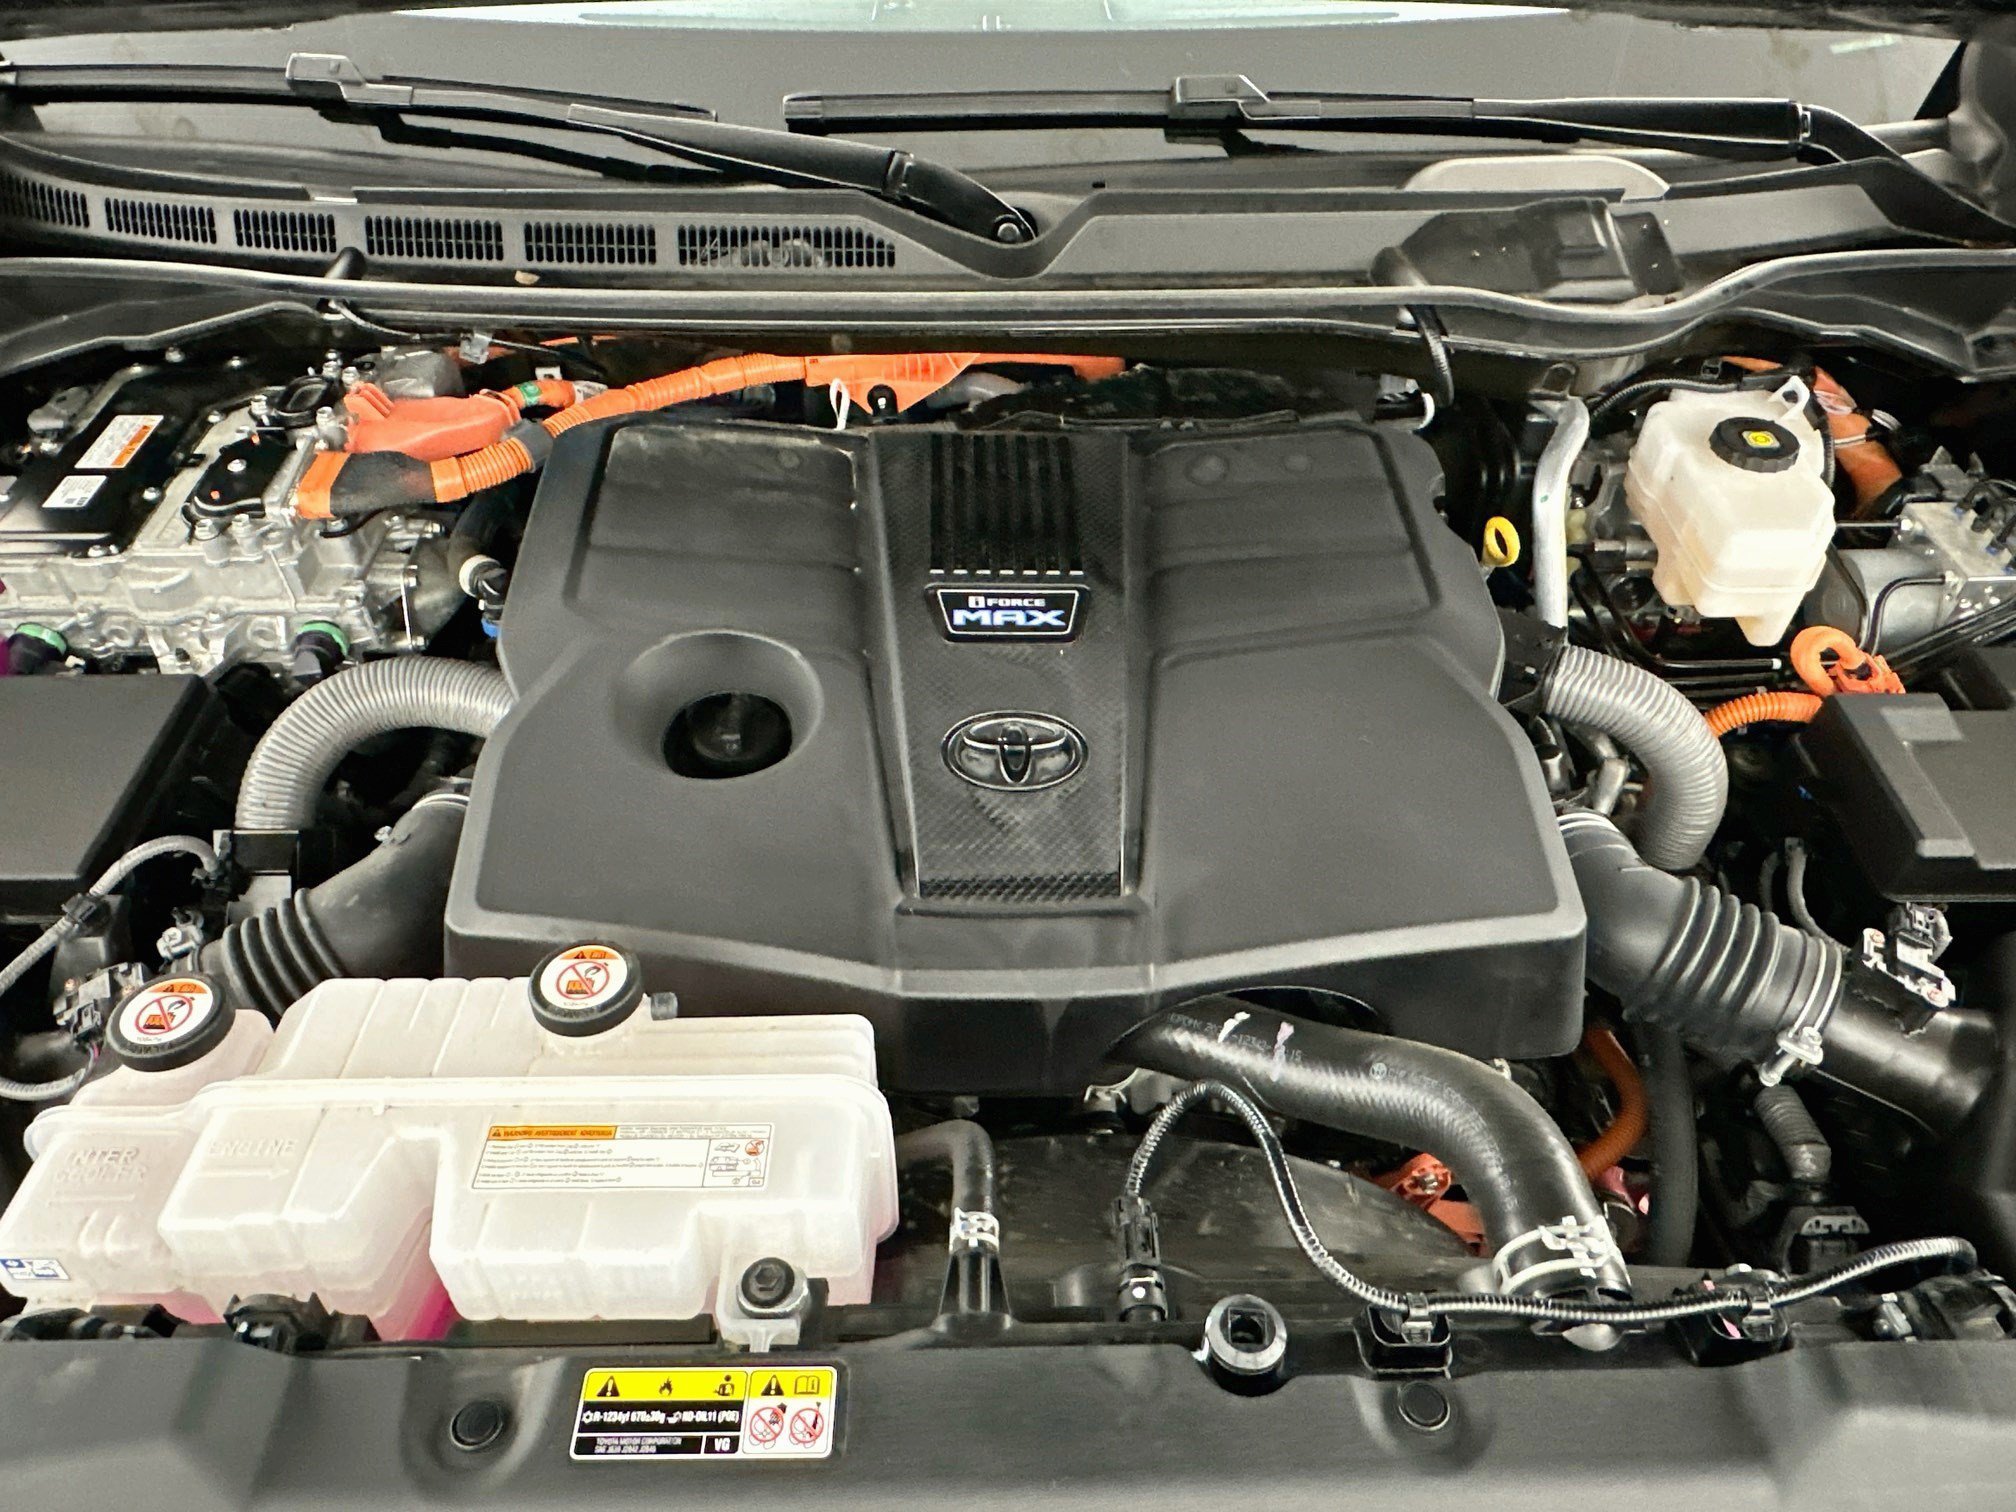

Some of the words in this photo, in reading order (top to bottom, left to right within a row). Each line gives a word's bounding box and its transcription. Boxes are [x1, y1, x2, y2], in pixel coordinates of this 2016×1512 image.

[952, 609, 1067, 626] MAX
[65, 1146, 140, 1166] INTER
[208, 1139, 297, 1157] ENGINE
[714, 1437, 731, 1452] VG
